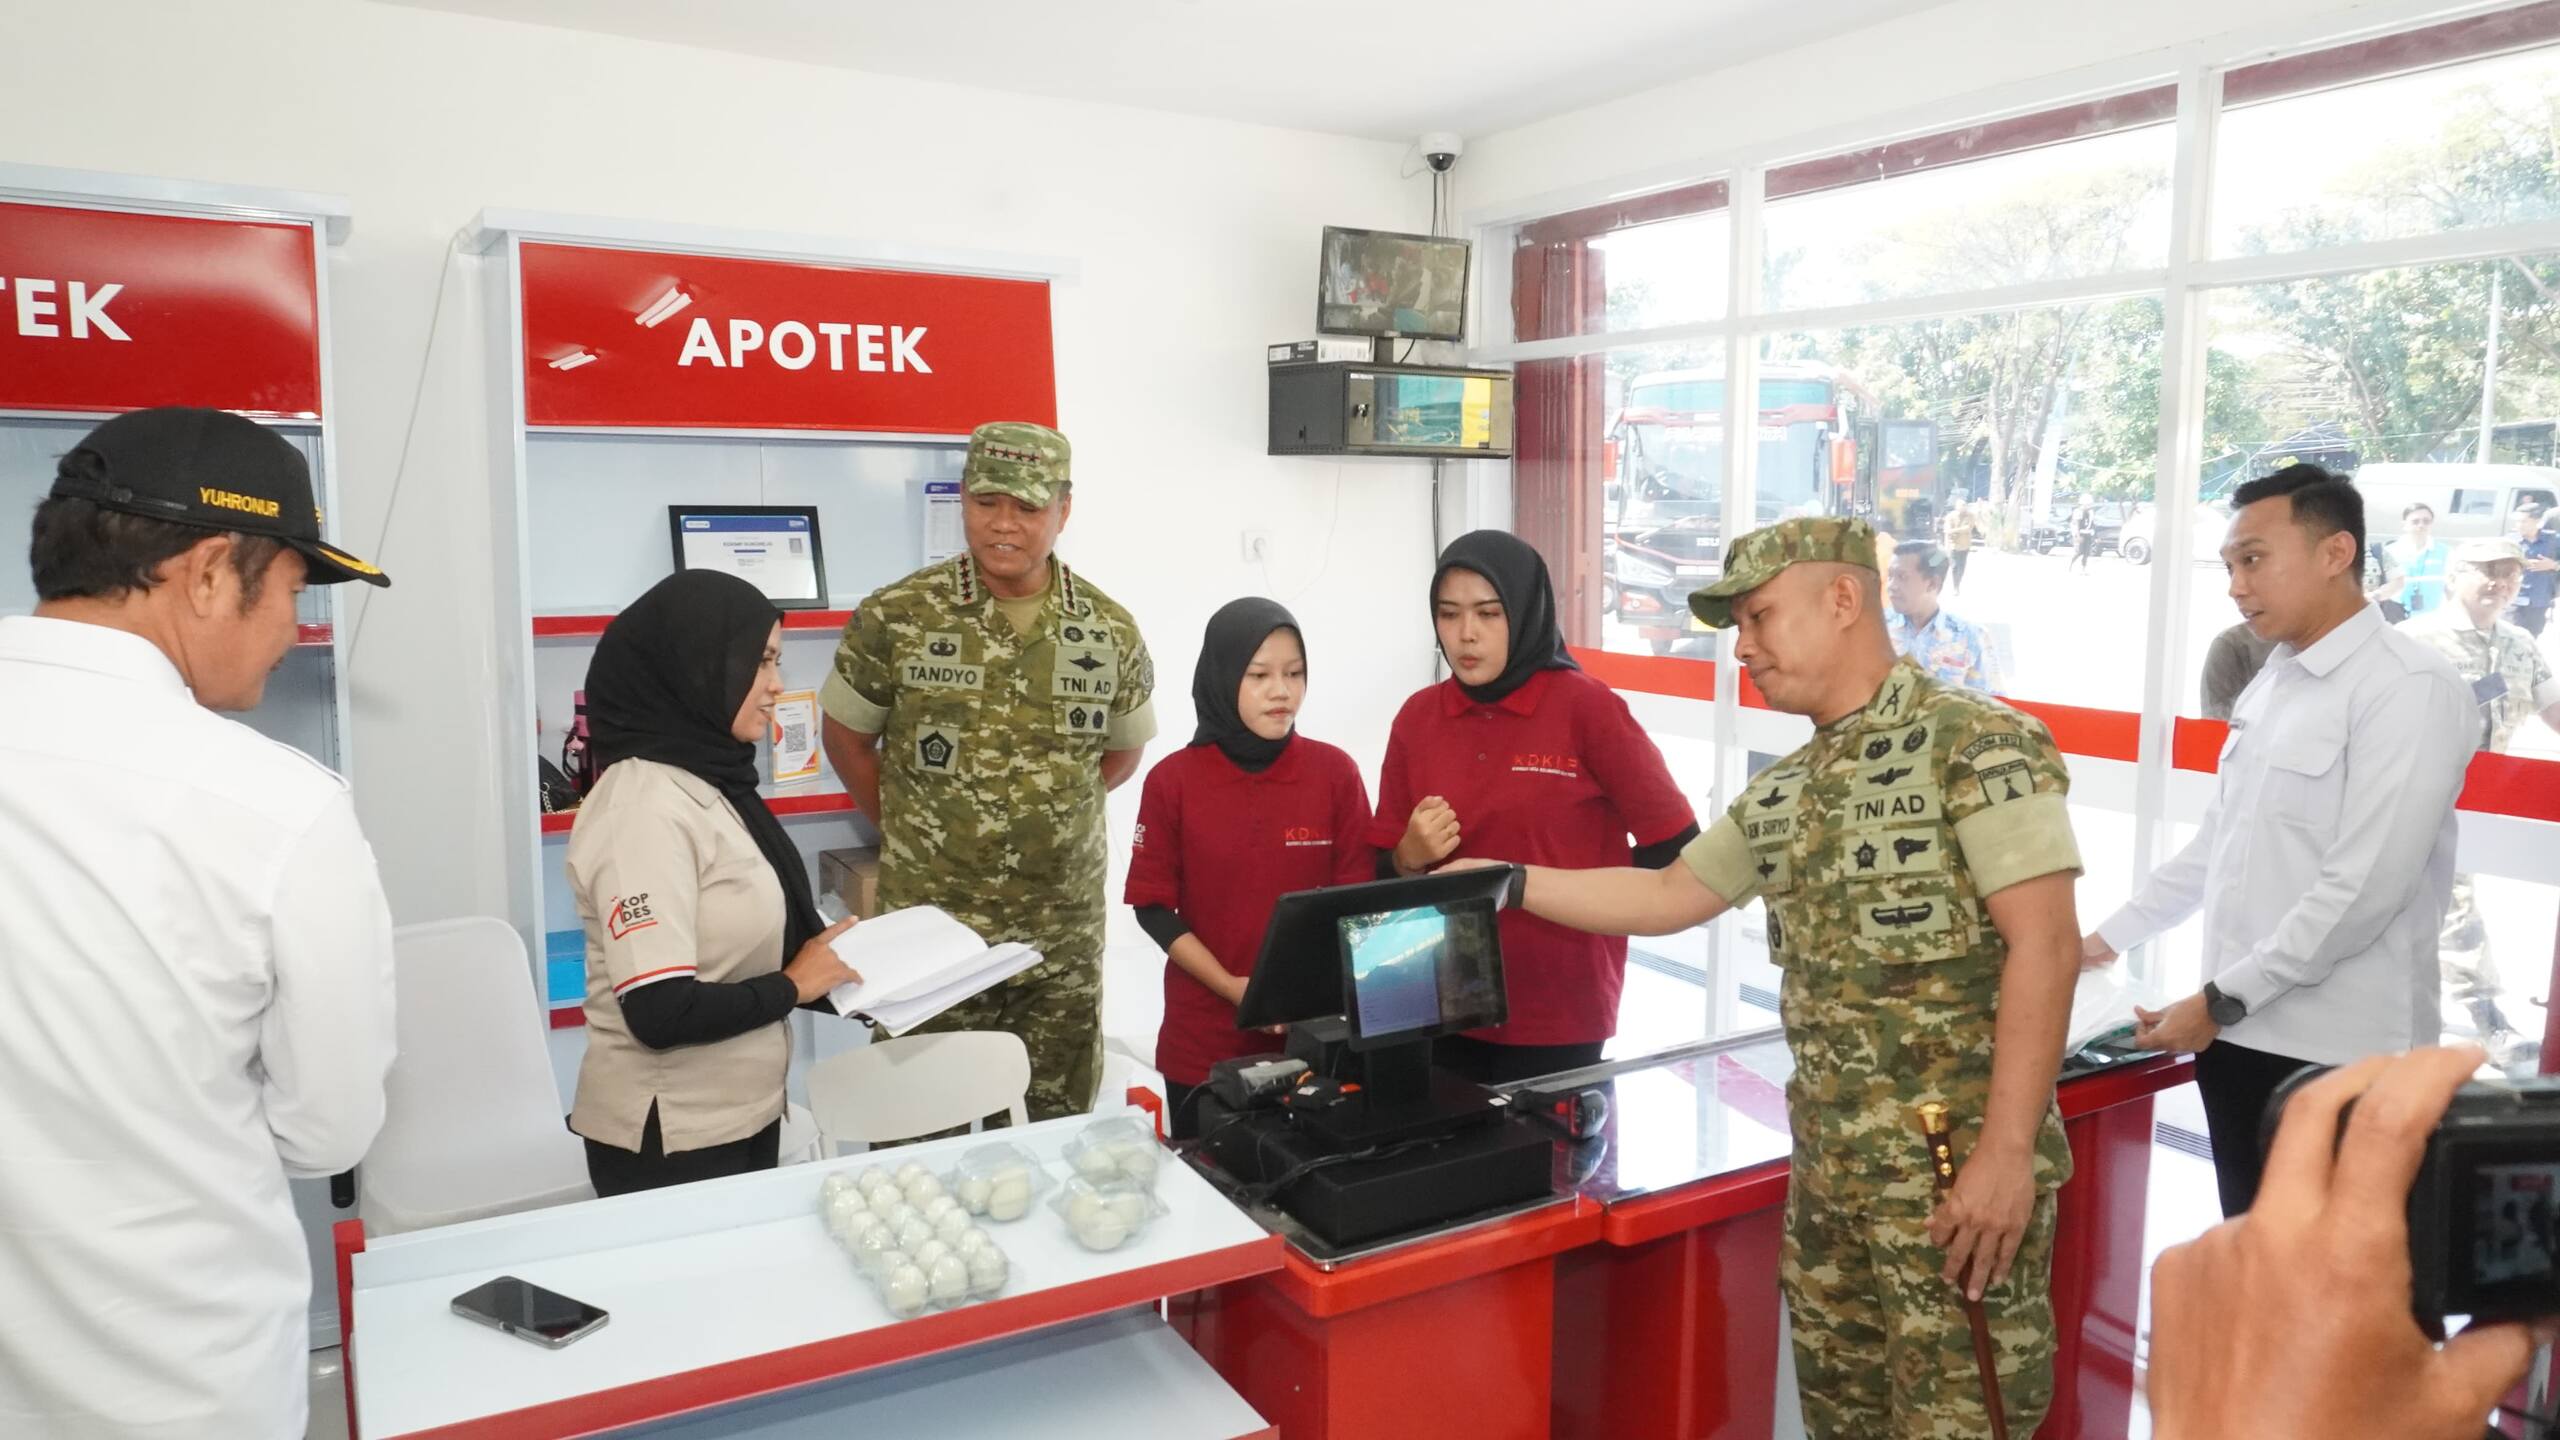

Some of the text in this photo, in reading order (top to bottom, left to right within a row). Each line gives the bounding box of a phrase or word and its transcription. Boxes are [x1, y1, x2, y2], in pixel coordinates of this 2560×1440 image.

[0, 277, 133, 341] EK
[677, 317, 933, 374] APOTEK
[199, 486, 280, 518] YUHRONUR
[908, 666, 977, 686] TANDYO
[1060, 677, 1112, 695] TNI AD
[1854, 794, 1925, 821] TNI AD
[620, 893, 649, 910] KOP
[622, 905, 652, 922] DES
